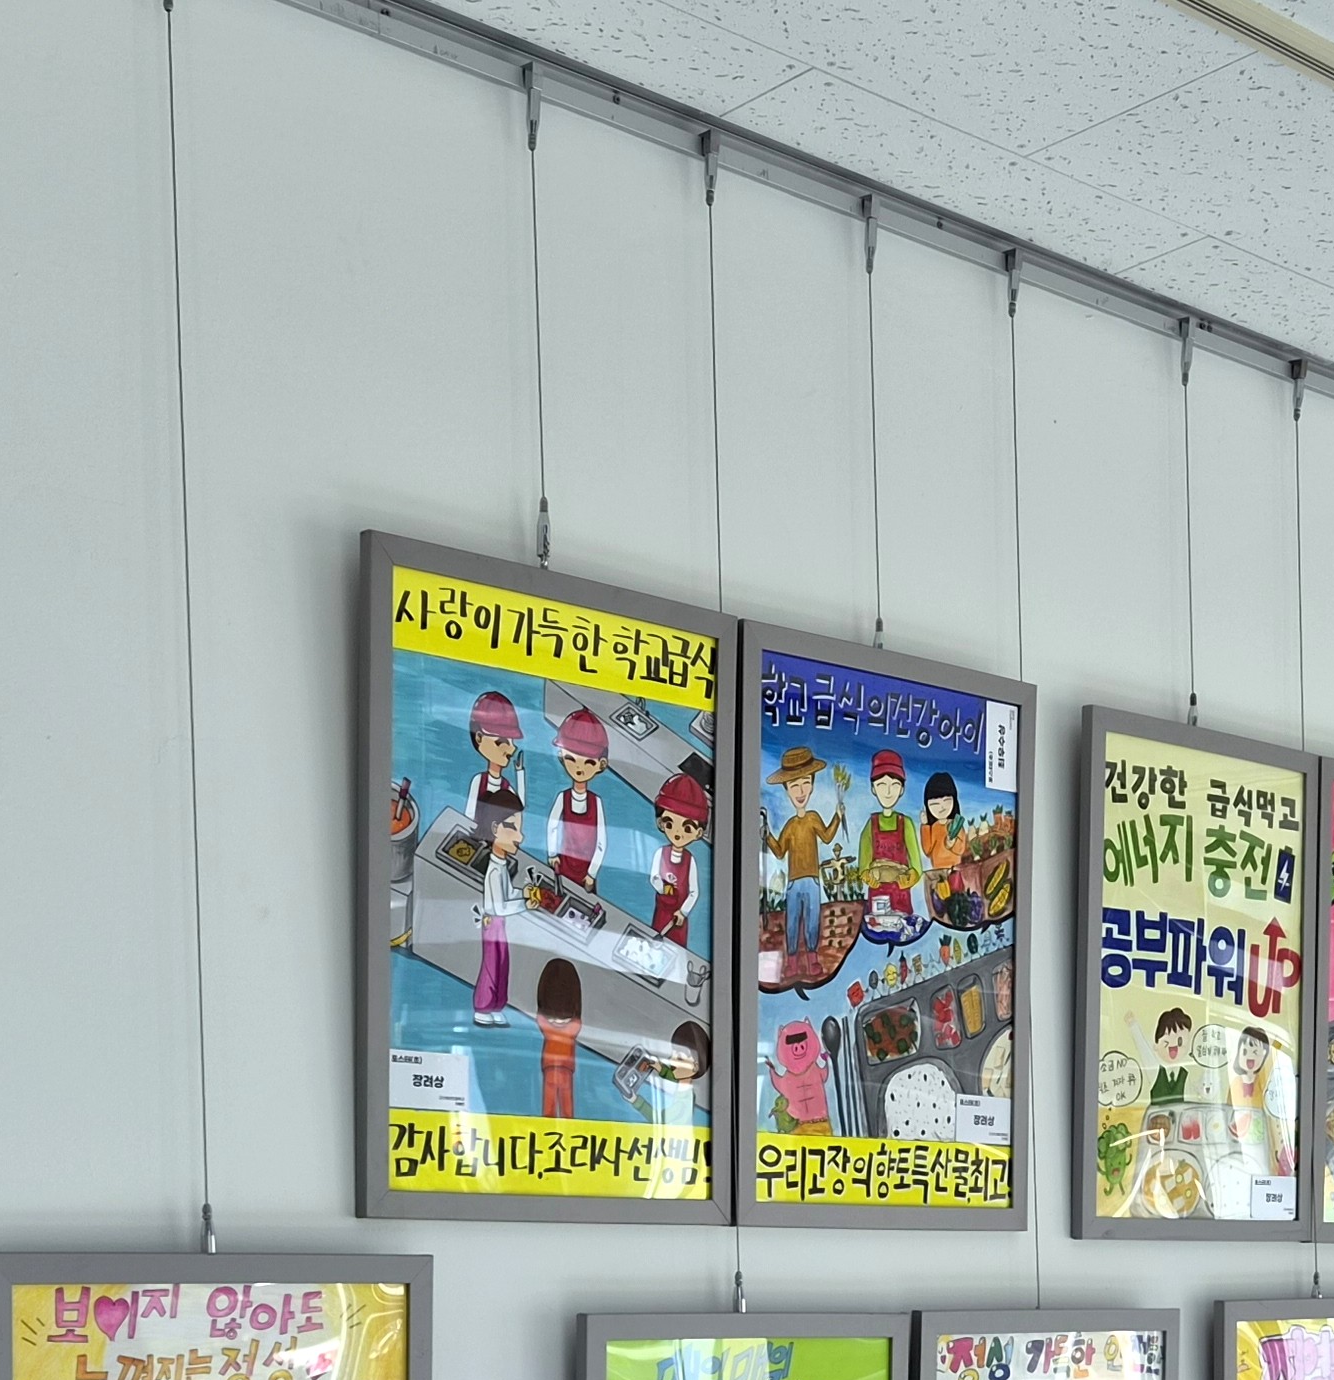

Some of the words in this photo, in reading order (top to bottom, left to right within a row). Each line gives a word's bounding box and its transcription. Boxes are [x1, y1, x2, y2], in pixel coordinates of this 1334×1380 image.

[1104, 759, 1188, 811] 건강한
[1102, 813, 1193, 889] 에너지
[1202, 820, 1273, 902] 충전
[412, 1073, 445, 1089] 장려상
[47, 1283, 181, 1343] 보이지
[205, 1284, 324, 1341] 않아도
